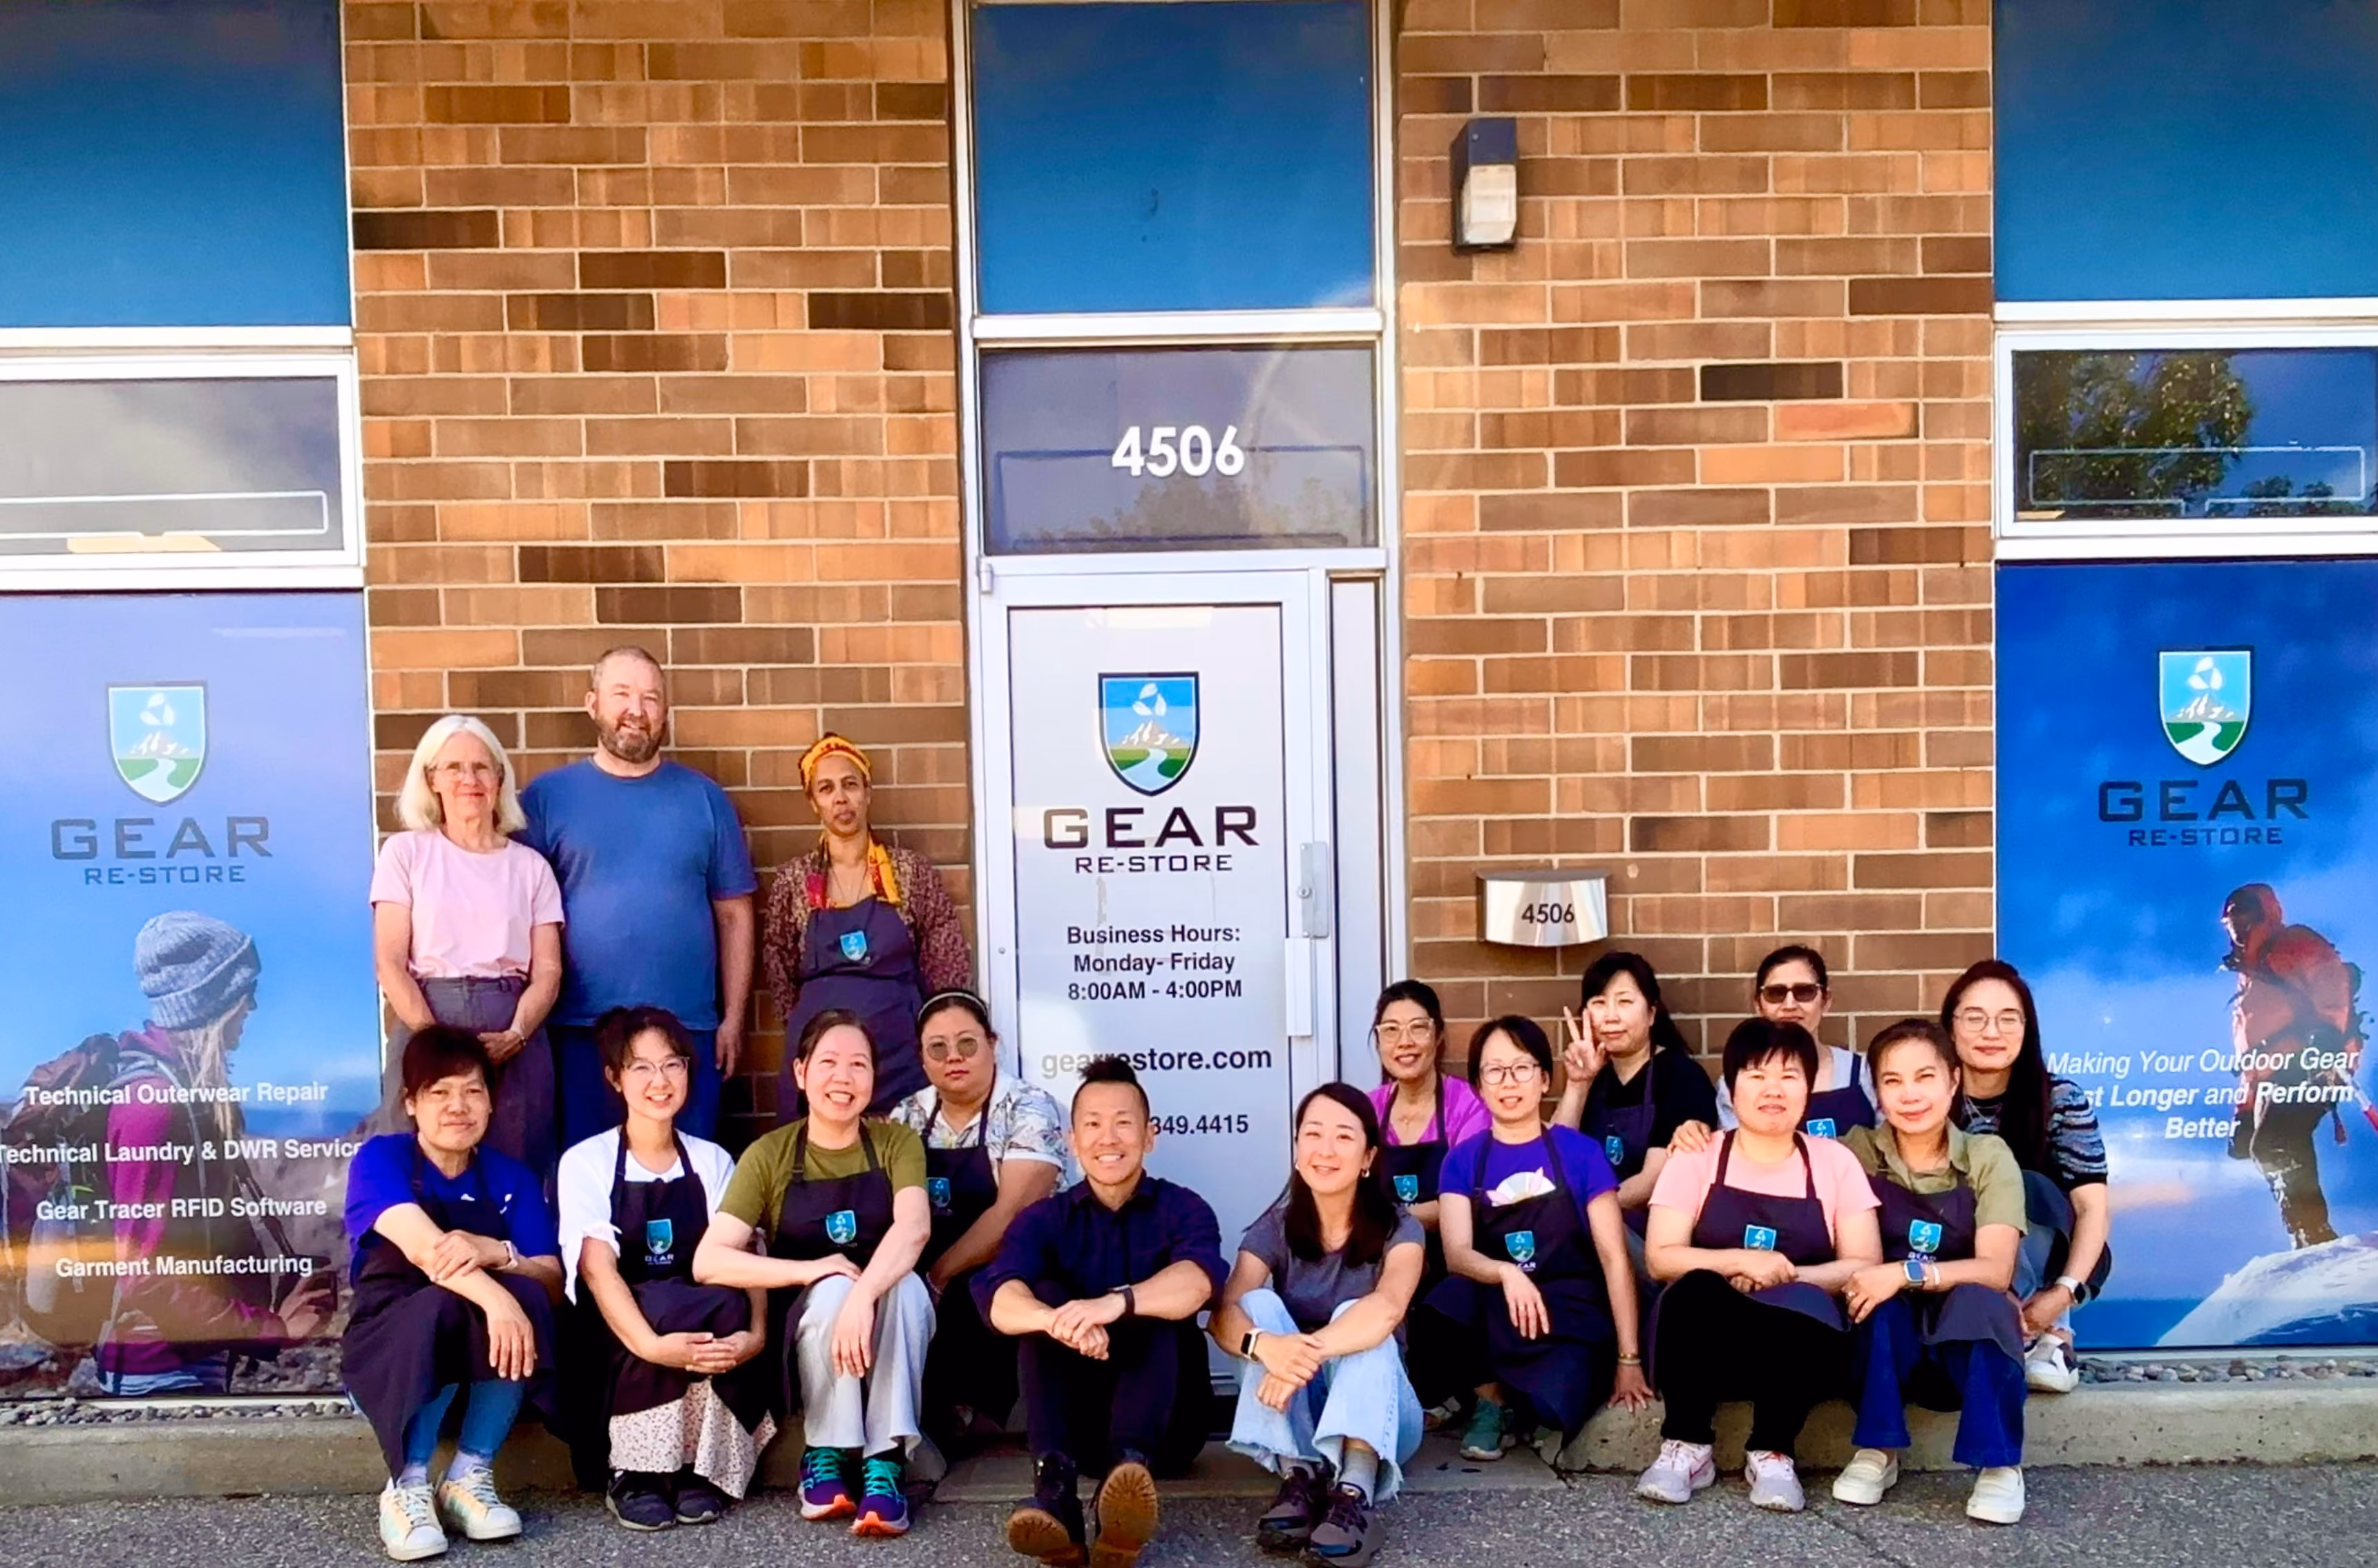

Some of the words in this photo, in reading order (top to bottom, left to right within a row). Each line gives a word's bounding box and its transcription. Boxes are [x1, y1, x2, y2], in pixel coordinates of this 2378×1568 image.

[1112, 425, 1244, 477] 4506
[2098, 778, 2309, 823] GEAR
[50, 816, 273, 860] GEAR
[1043, 805, 1260, 849] GEAR
[2128, 827, 2283, 847] RE-STORE
[84, 866, 245, 885] RE-STORE
[1075, 854, 1233, 873] RE-STORE
[1521, 903, 1575, 924] 4506
[1067, 925, 1164, 945] Business
[1170, 924, 1241, 942] Hours:
[1074, 954, 1163, 975] Monday-
[1170, 953, 1236, 973] Friday
[1068, 982, 1145, 1001] 8:00AM
[1166, 979, 1242, 999] 4:00PM
[2046, 1051, 2131, 1079] Making
[2140, 1050, 2194, 1073] Your
[2199, 1049, 2294, 1073] Outdoor
[2300, 1046, 2359, 1071] Gear
[26, 1084, 131, 1107] Technical
[137, 1082, 250, 1105] Outerwear
[257, 1081, 329, 1108] Repair
[2110, 1084, 2198, 1112] Longer
[2205, 1084, 2249, 1105] and
[2255, 1082, 2355, 1105] Perform
[1150, 1114, 1248, 1135] 349.4415
[2165, 1116, 2241, 1139] Better
[105, 1142, 194, 1166] Laundry
[201, 1140, 216, 1160] &
[224, 1138, 278, 1160] DWR
[37, 1200, 89, 1220] Gear
[95, 1198, 164, 1220] Tracer
[171, 1198, 224, 1218] RFID
[230, 1196, 326, 1217] Software
[56, 1256, 150, 1277] Garment
[156, 1254, 312, 1278] Manufacturing
